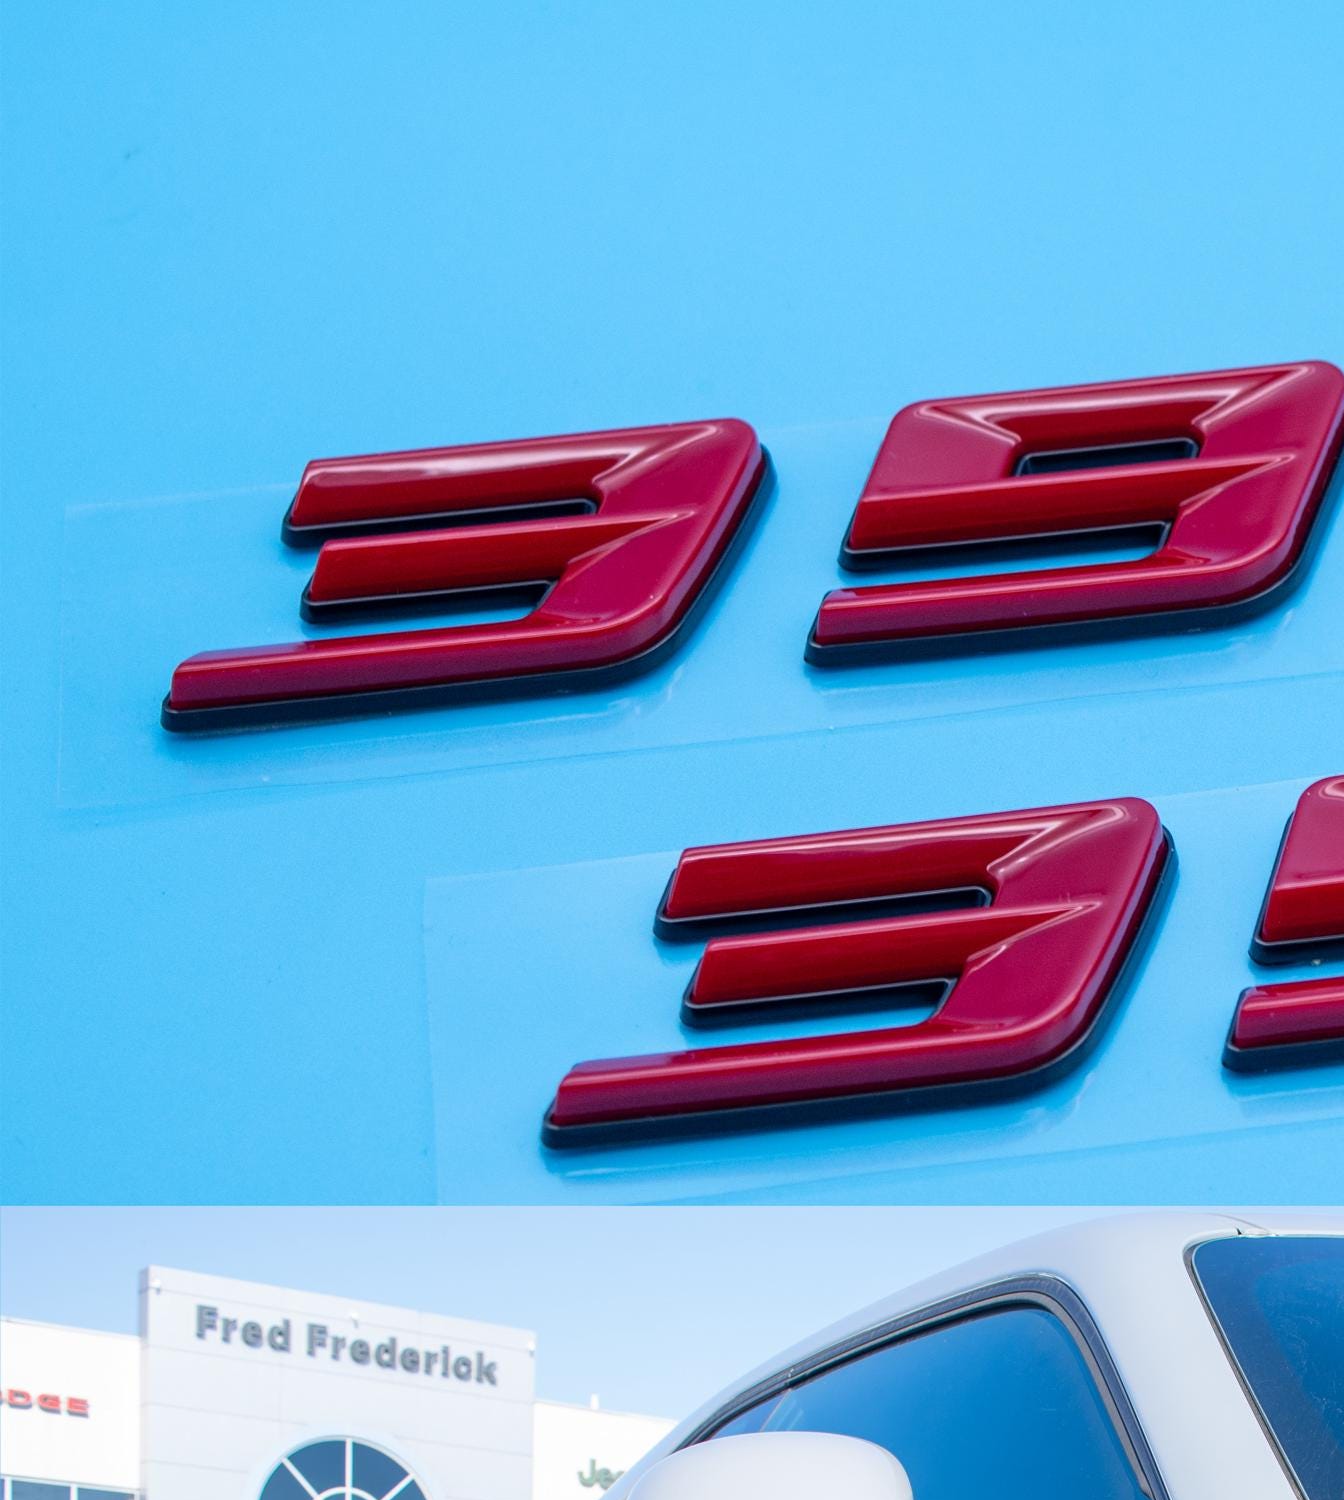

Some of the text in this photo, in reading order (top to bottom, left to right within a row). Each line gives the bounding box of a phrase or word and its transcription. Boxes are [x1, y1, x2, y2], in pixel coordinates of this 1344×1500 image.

[196, 1304, 498, 1386] Fred Frederick
[0, 1388, 89, 1418] DGE
[577, 1458, 624, 1490] Je
